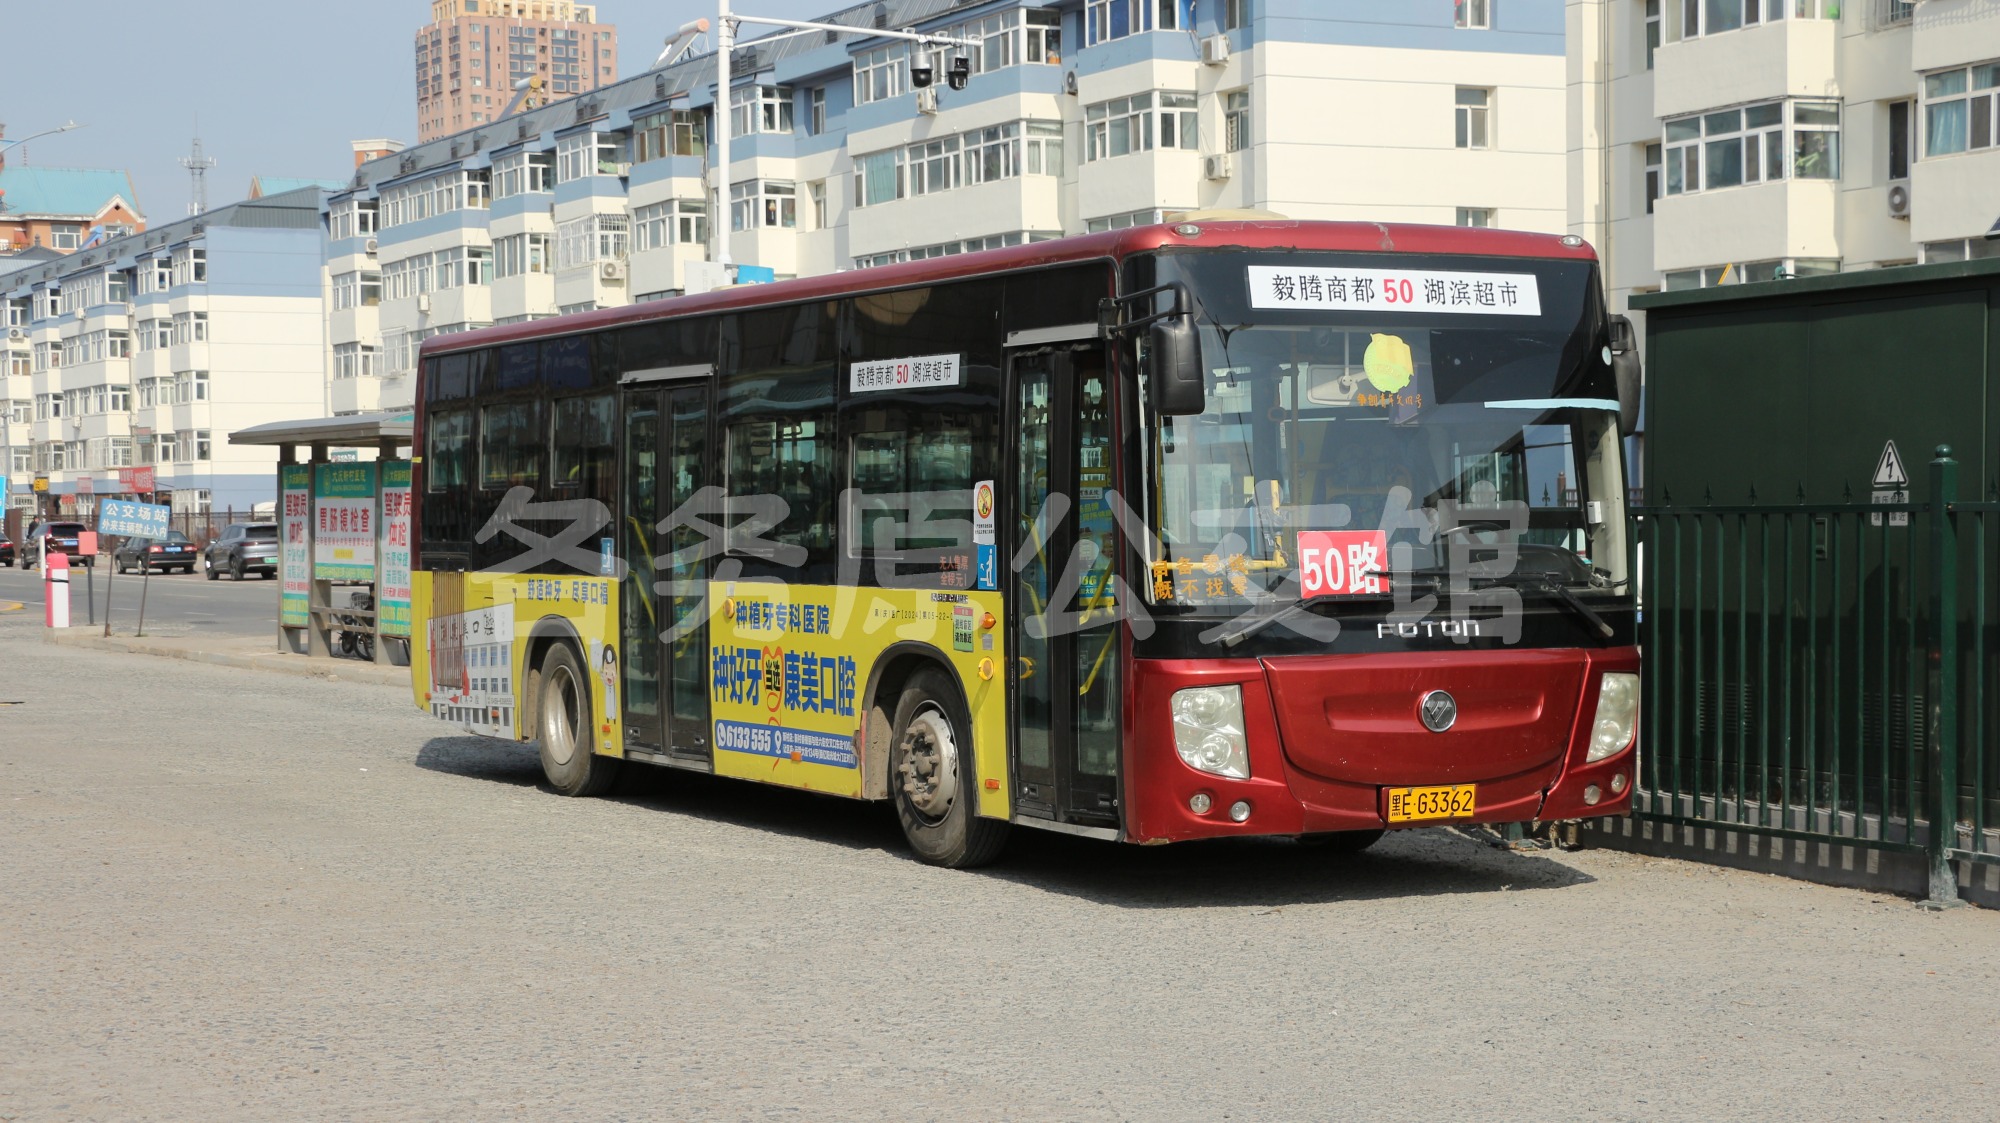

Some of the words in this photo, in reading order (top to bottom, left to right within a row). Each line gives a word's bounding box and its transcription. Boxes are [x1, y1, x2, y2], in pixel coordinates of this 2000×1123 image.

[1271, 273, 1375, 303] 毅腾商都
[1383, 278, 1414, 304] 50
[1423, 278, 1519, 307] 湖滨超市
[857, 365, 894, 387] 毅腾商都
[897, 364, 908, 384] 50
[912, 359, 953, 383] 湖滨超市
[105, 503, 167, 523] 公交场站
[285, 493, 307, 517] 驾驶员
[384, 492, 411, 517] 驾驶员
[102, 518, 167, 538] 外来车辆禁止入内
[289, 521, 303, 544] 体检
[319, 507, 370, 533] 胃肠镜检查
[388, 521, 407, 547] 体检
[939, 555, 969, 570] 无人售票
[1153, 553, 1249, 577] 自备零钱
[1302, 541, 1383, 596] 50路
[1153, 575, 1248, 601] 概不找零
[736, 600, 830, 635] 种植牙专科医院
[1377, 619, 1480, 639] FOTON
[713, 644, 762, 706] 种好牙
[765, 659, 781, 692] 当选
[784, 649, 856, 717] 康美口腔
[726, 724, 750, 750] 6133
[751, 728, 771, 752] 555
